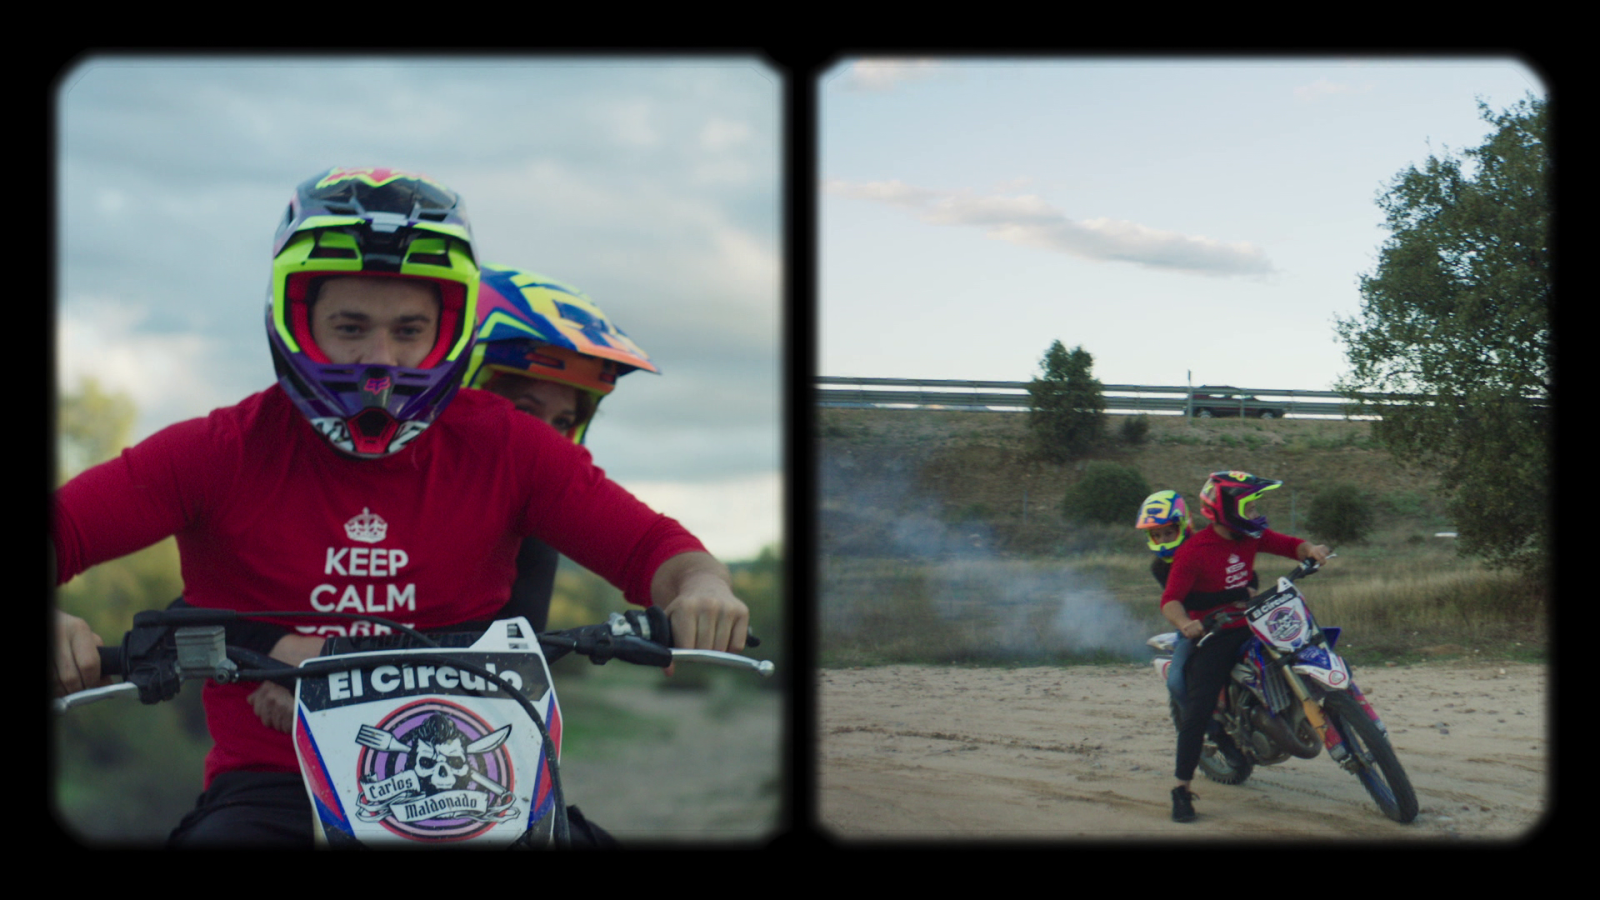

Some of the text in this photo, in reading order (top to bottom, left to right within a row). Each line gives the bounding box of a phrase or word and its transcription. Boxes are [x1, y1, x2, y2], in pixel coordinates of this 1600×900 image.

[324, 546, 409, 577] KEEP
[309, 583, 416, 613] CALM
[328, 668, 363, 700] El
[369, 777, 413, 799] Carlos
[404, 793, 477, 819] Maldonado
